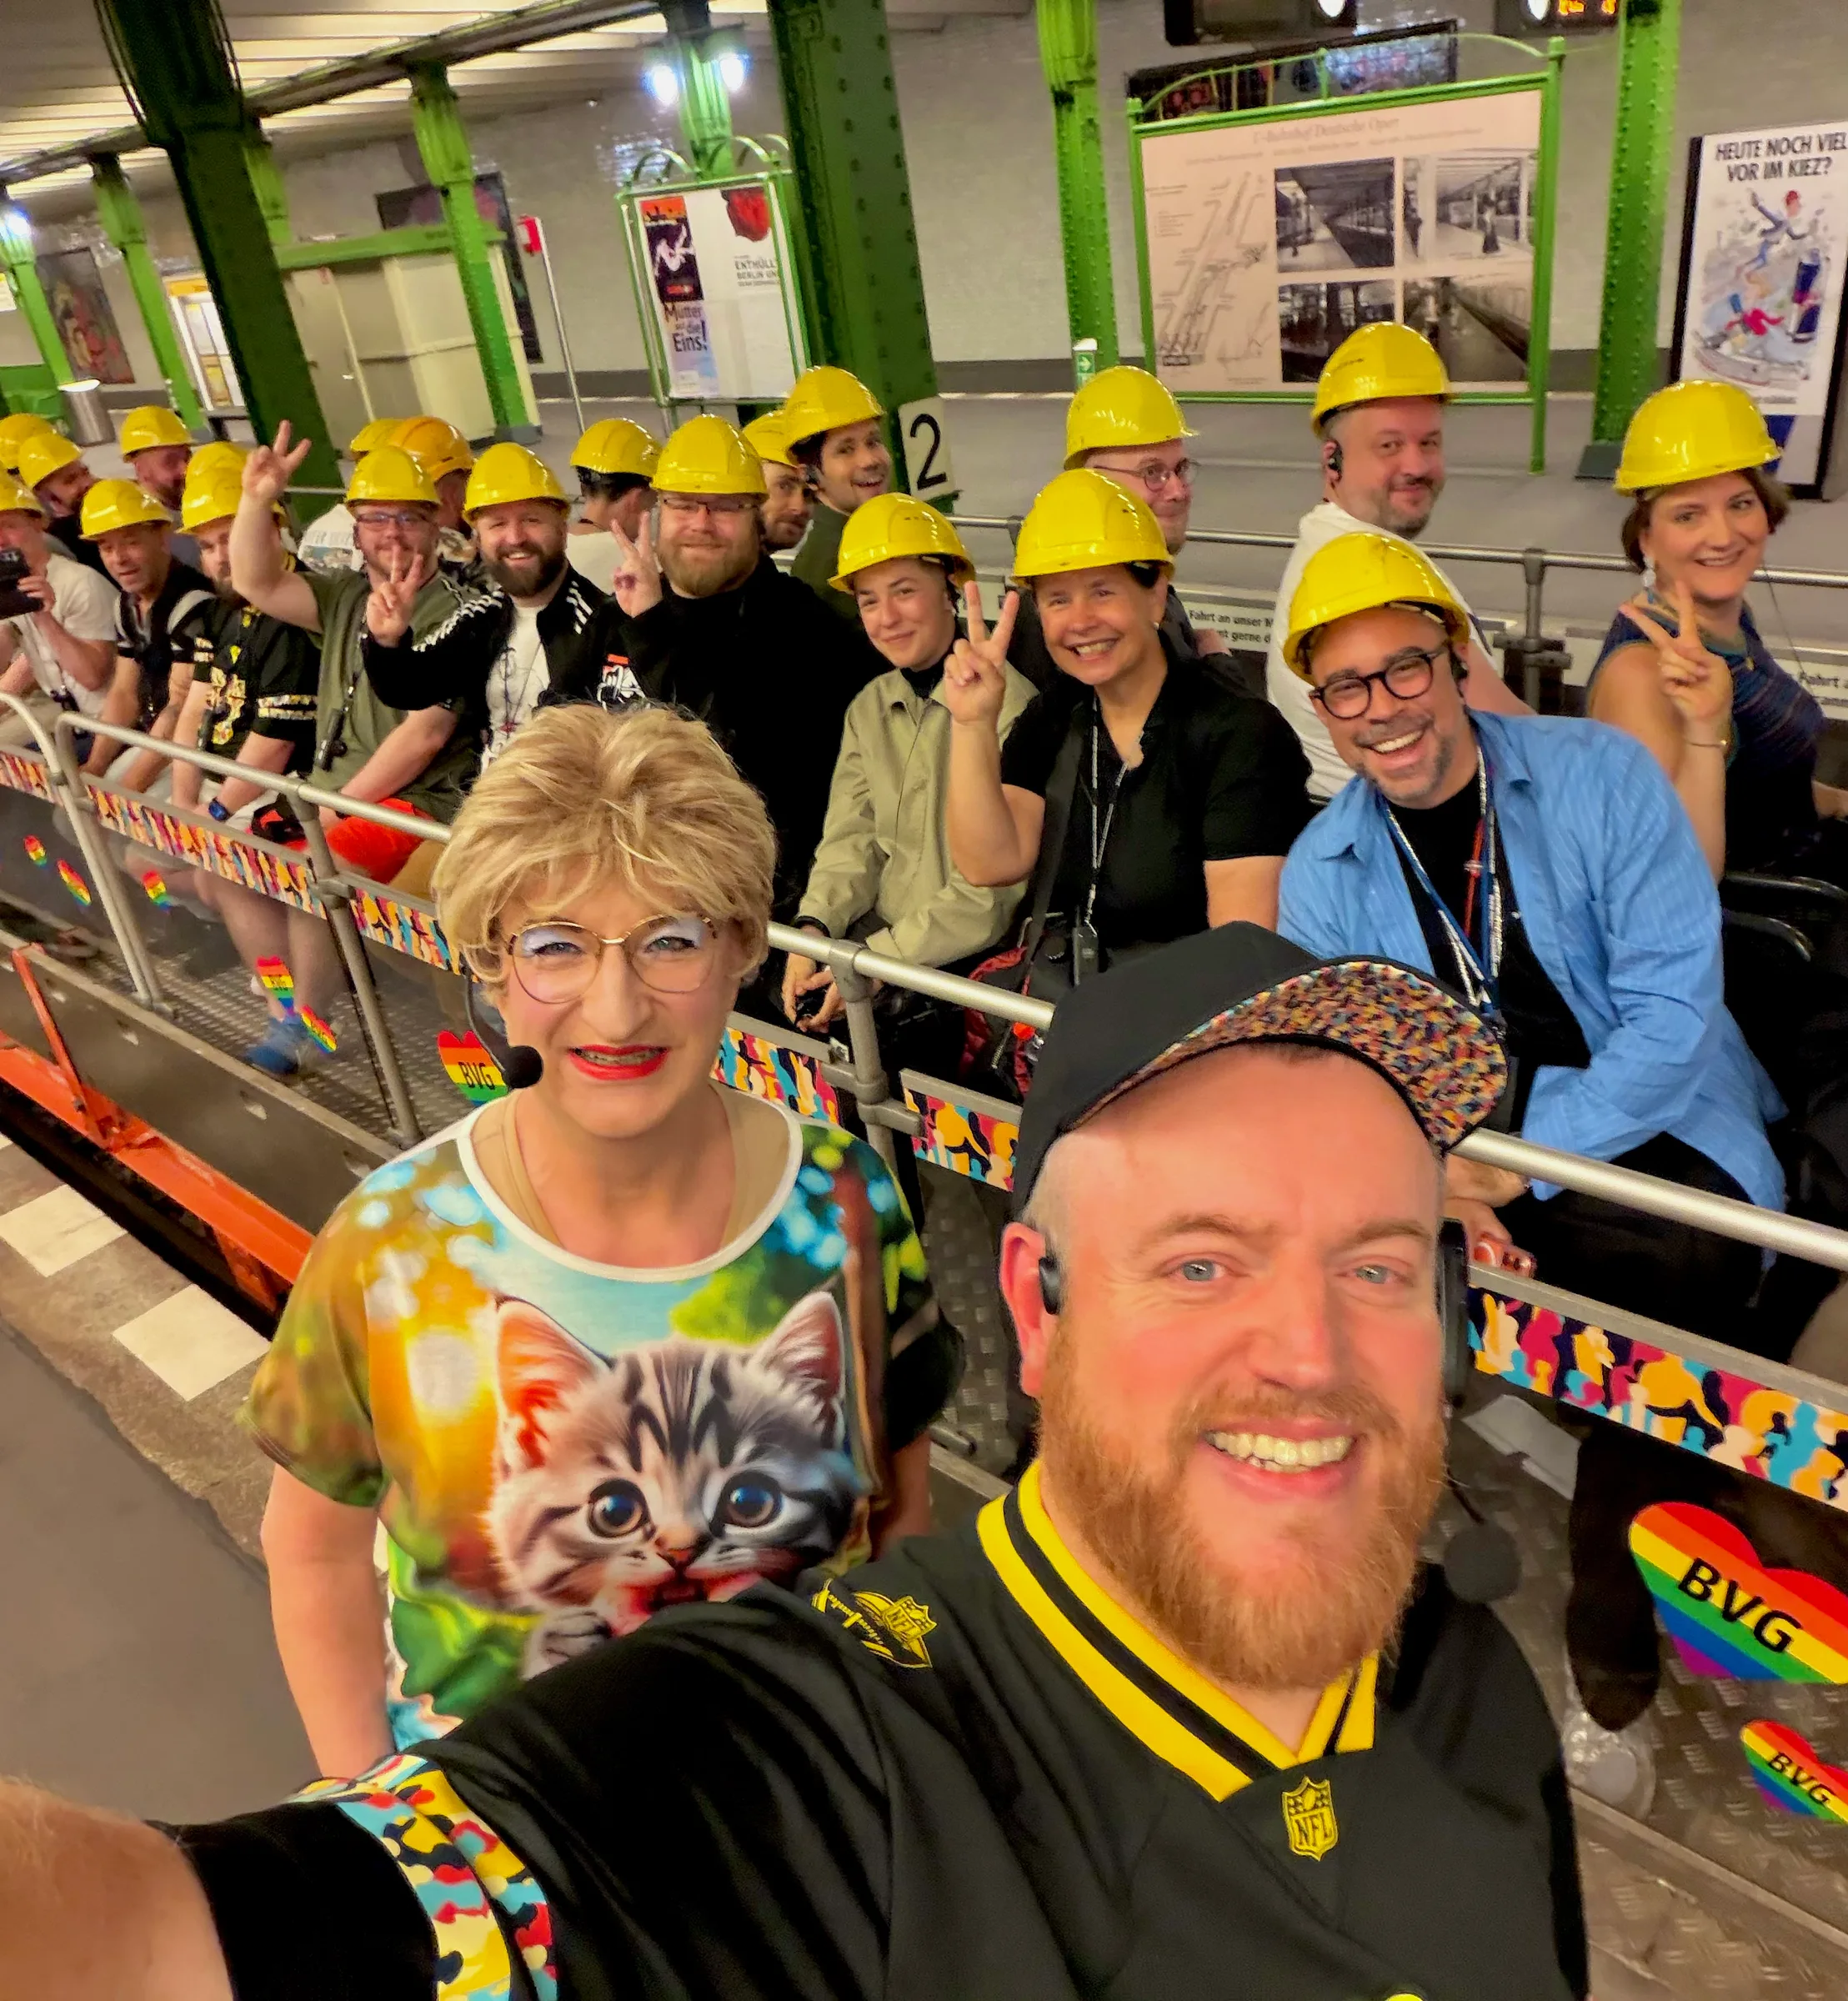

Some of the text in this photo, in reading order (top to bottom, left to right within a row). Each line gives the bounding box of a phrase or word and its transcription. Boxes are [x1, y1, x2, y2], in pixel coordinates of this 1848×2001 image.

[1715, 132, 1847, 161] HEUTE NOCH VIEL
[1727, 157, 1832, 182] VOR IM KIEZ?
[672, 319, 708, 352] Eins!
[910, 414, 948, 490] 2
[1189, 609, 1215, 622] Fahrt
[1218, 614, 1231, 624] an
[1234, 617, 1262, 627] unser
[1232, 632, 1262, 643] gerne
[458, 1061, 495, 1091] BVG
[1677, 1557, 1803, 1653] BVG
[1768, 1752, 1835, 1805] BVG
[1295, 1812, 1334, 1848] NFL
